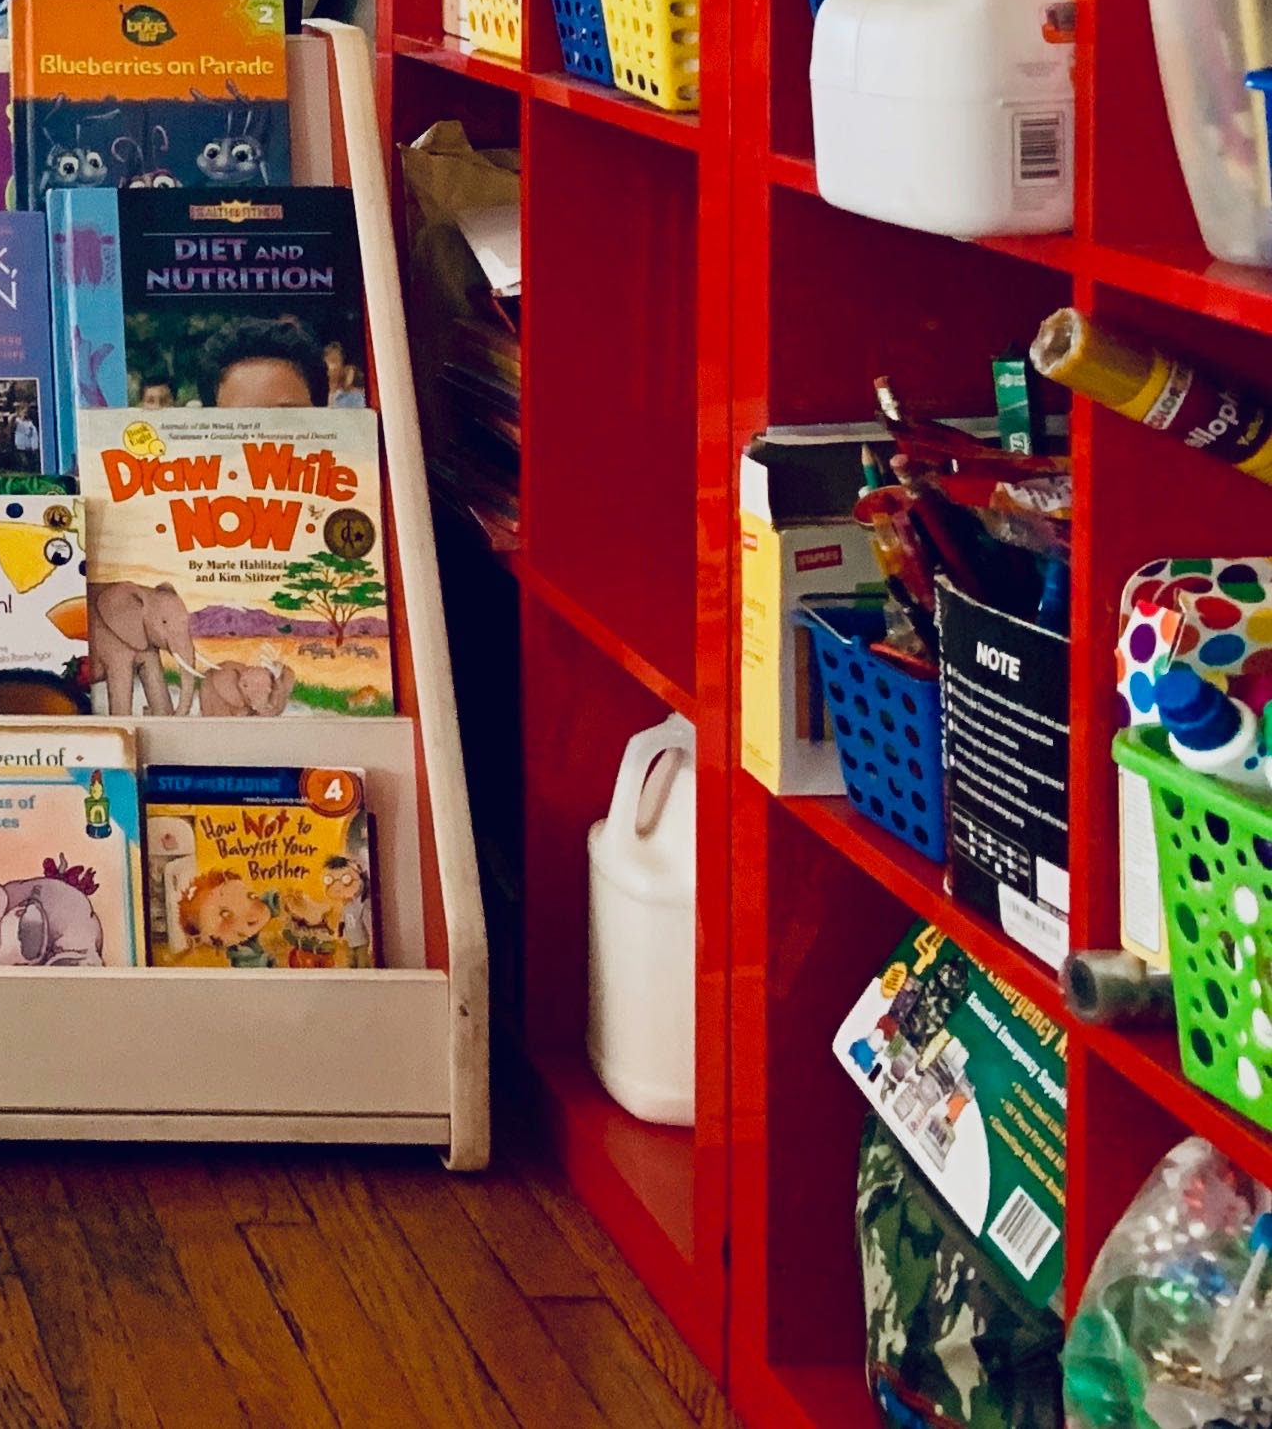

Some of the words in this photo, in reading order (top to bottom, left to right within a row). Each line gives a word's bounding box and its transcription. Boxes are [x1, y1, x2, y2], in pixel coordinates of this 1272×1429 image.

[259, 5, 274, 24] 2
[39, 55, 163, 76] Blueberries
[167, 58, 196, 75] on
[199, 56, 275, 76] Parade
[174, 238, 247, 262] DIET
[254, 245, 305, 260] AND
[145, 266, 334, 292] NUTRITION
[101, 447, 223, 503] Draw
[242, 442, 359, 502] Write
[169, 495, 304, 553] NOW
[188, 559, 203, 572] By
[206, 559, 237, 571] Marie
[195, 572, 216, 583] and
[218, 572, 243, 583] Kim
[245, 572, 282, 583] Stitzer
[976, 641, 1021, 682] NOTE
[46, 746, 67, 767] of
[158, 776, 193, 791] STEP
[215, 776, 281, 792] READING
[323, 777, 345, 802] 4
[17, 794, 36, 810] of
[199, 815, 238, 840] How
[242, 809, 291, 839] Not
[296, 816, 313, 836] to
[216, 836, 279, 860] Babysit
[281, 835, 319, 858] Your
[247, 859, 312, 881] Brother
